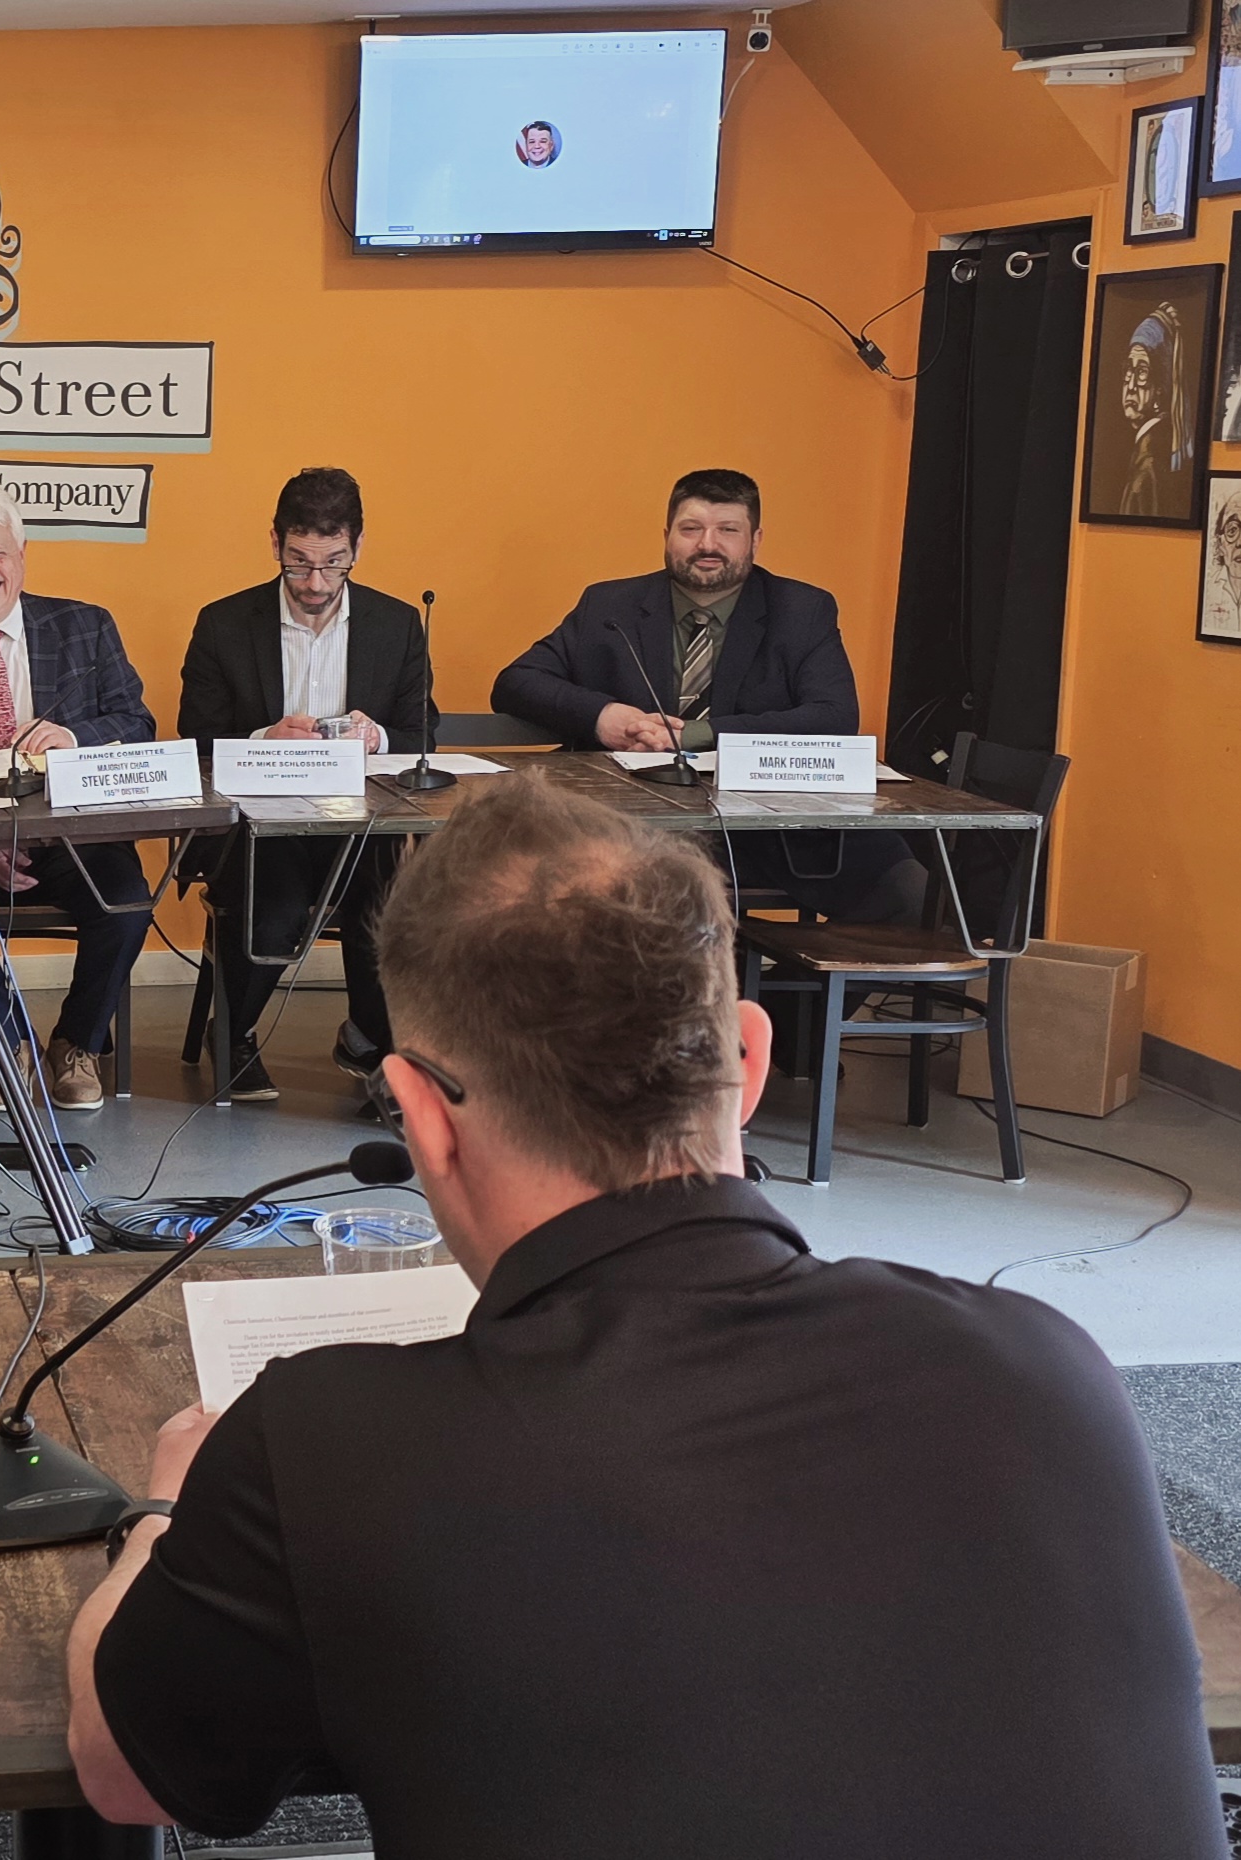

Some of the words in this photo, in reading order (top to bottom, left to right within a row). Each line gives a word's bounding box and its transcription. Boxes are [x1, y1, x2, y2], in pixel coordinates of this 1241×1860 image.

[79, 752, 115, 760] FINANCE
[117, 748, 165, 758] COMMITTEE
[97, 763, 128, 772] MAJORITY
[759, 756, 787, 768] MARK
[789, 758, 835, 769] FOREMAN
[82, 774, 109, 788] STEVE
[113, 770, 167, 785] SAMUELSON
[749, 772, 773, 780] SENIOR
[775, 773, 810, 781] EXECUTIVE
[813, 774, 845, 782] DIRECTOR
[121, 786, 149, 795] DISTRICT
